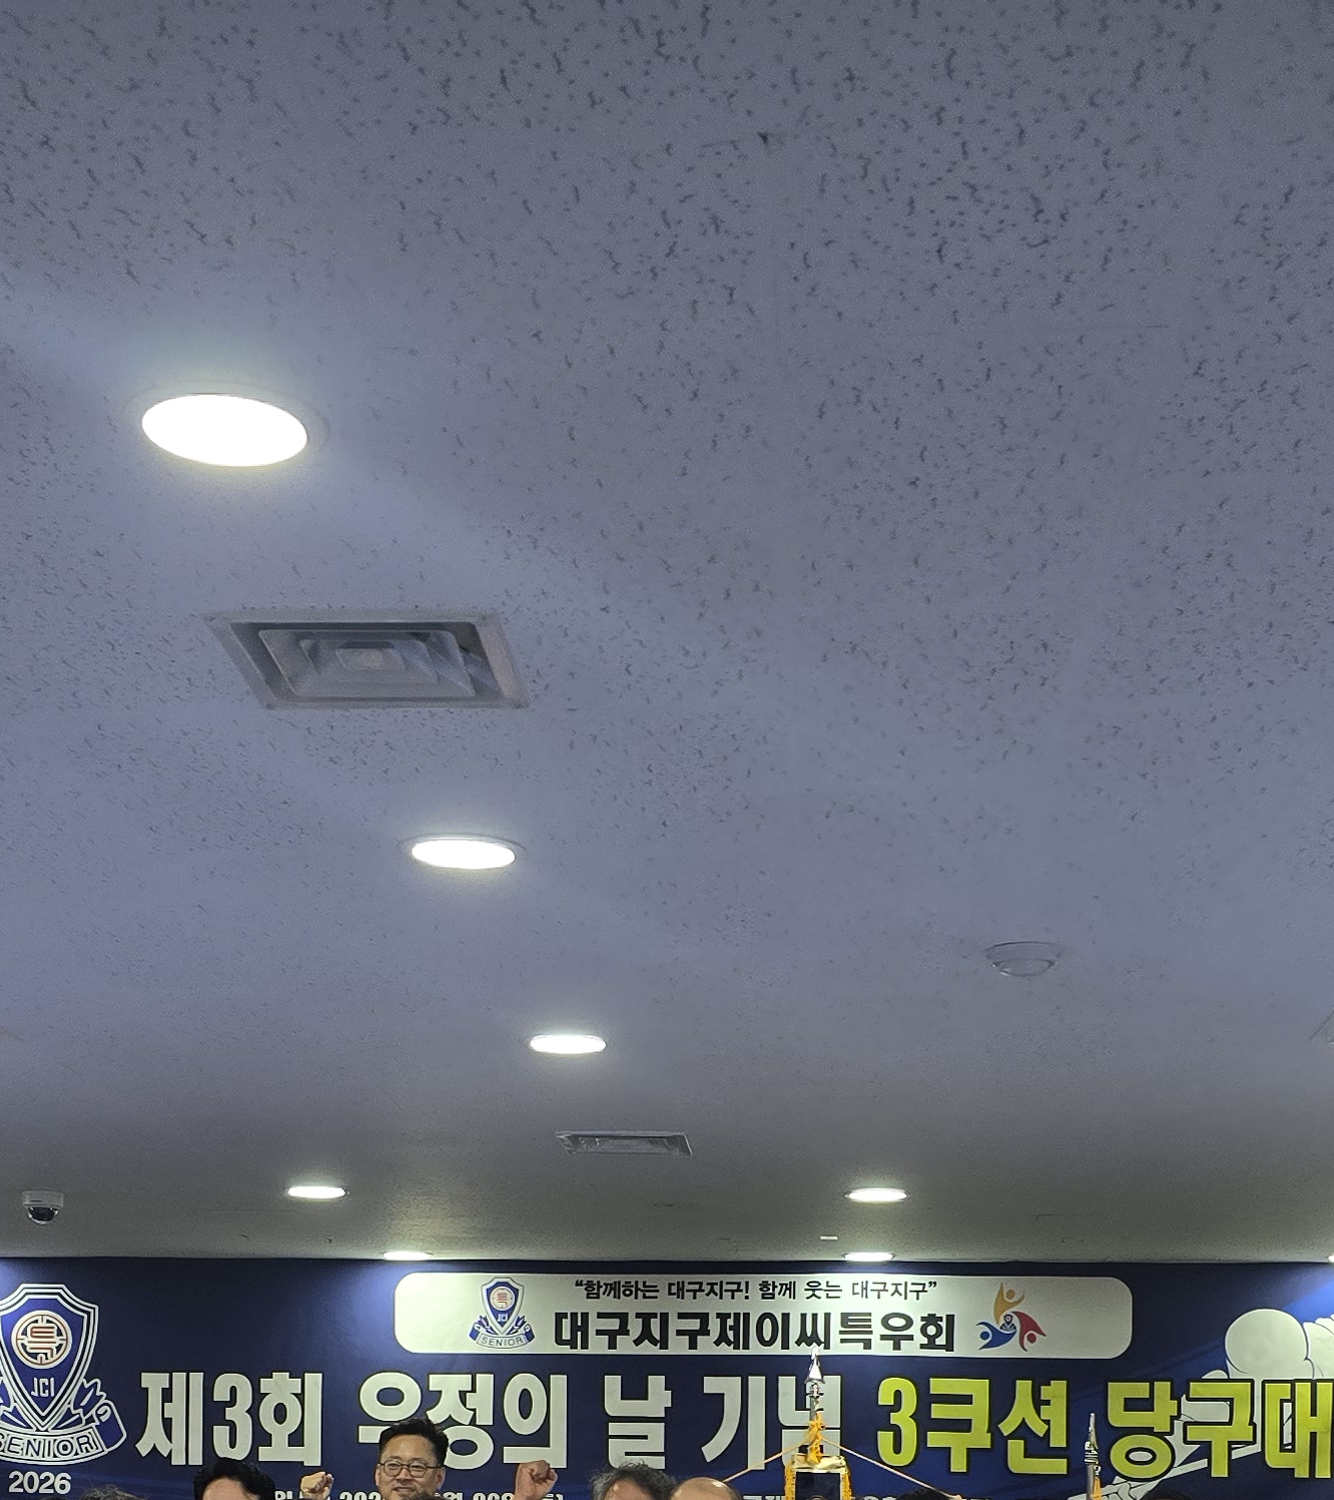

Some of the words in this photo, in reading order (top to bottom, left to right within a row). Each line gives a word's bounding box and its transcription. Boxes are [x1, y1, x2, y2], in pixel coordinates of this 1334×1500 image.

[575, 1280, 660, 1300] “함께하는
[668, 1280, 749, 1300] 대구지구!
[758, 1280, 796, 1300] 함께
[804, 1280, 843, 1300] 웃는
[852, 1280, 937, 1301] 대구지구”
[481, 1336, 524, 1348] SENIOR
[554, 1311, 956, 1353] 대구지구제이씨특우회
[30, 1376, 56, 1398] JCI
[134, 1371, 323, 1467] 제3회
[358, 1371, 568, 1470] 우정의
[604, 1374, 672, 1470] 날
[701, 1375, 842, 1471] 기념
[876, 1376, 1068, 1475] 3쿠션
[8, 1470, 72, 1495] 2026
